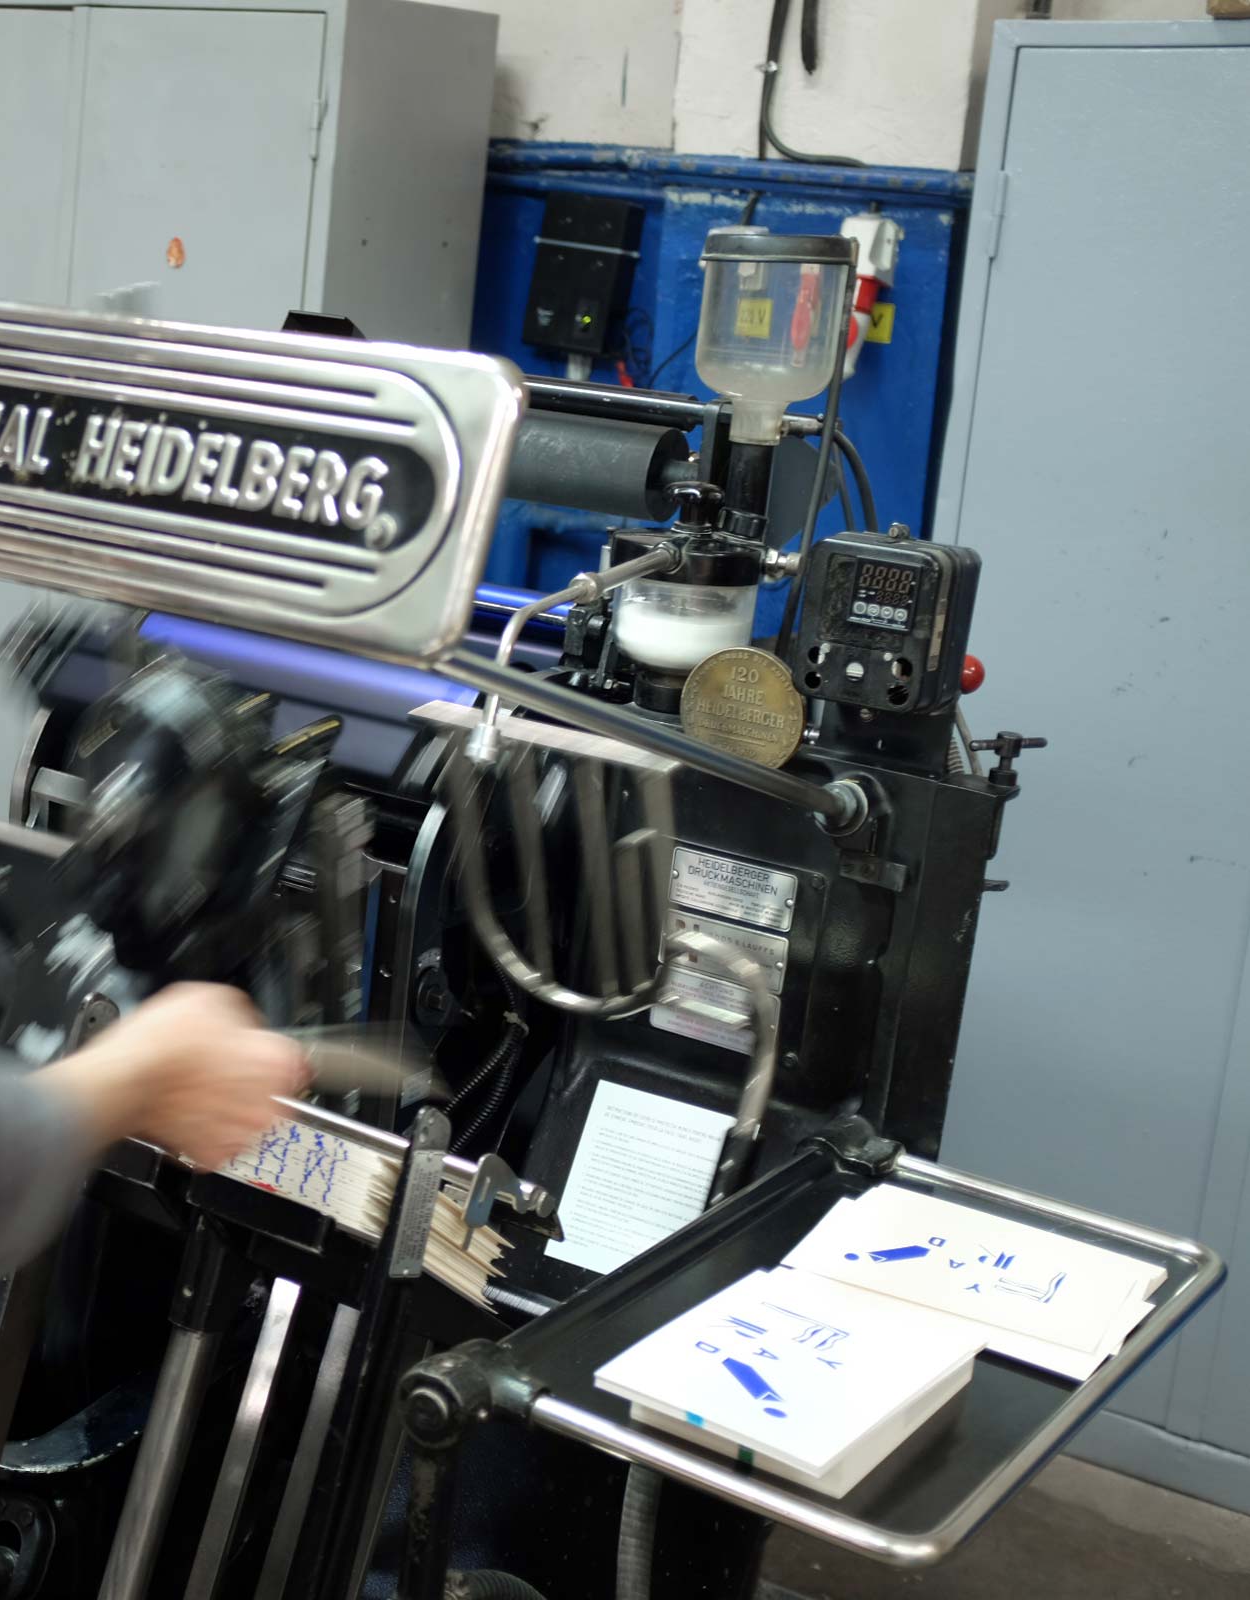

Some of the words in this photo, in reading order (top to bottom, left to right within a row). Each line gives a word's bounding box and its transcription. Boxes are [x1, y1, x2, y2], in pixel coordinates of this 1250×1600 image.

[71, 414, 389, 530] HEIDELBERG
[731, 666, 760, 684] 120
[721, 684, 766, 707] JAHRE
[695, 698, 786, 730] HEIDELBERGER
[687, 865, 779, 896] DRUCKMASCHINEN
[697, 857, 771, 882] HEIDELBERGER
